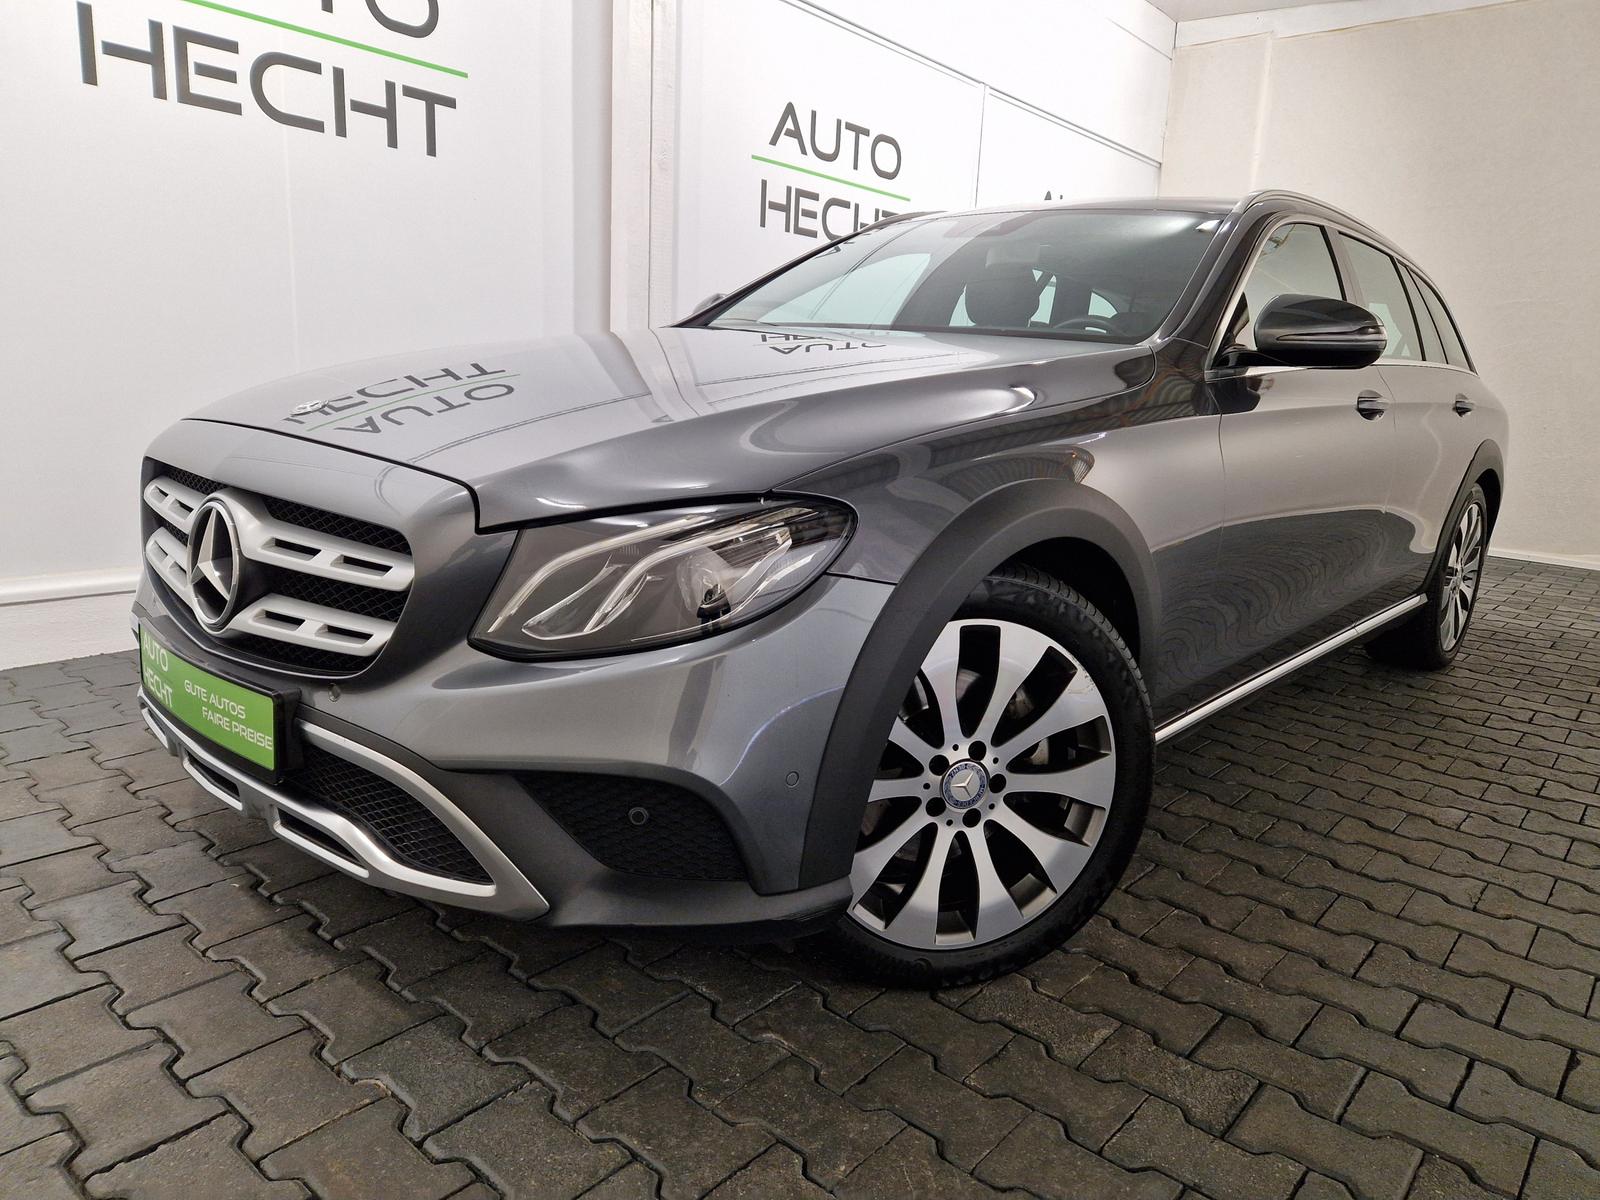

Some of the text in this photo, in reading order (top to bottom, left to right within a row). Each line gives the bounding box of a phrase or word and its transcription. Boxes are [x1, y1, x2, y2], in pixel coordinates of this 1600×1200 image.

[76, 0, 457, 158] HECHT
[769, 101, 902, 181] AUTO
[143, 631, 169, 673] AUTO
[143, 662, 173, 709] HECHT
[184, 679, 246, 719] GUTE AUTOS
[202, 706, 274, 751] FAIRE PREISE
